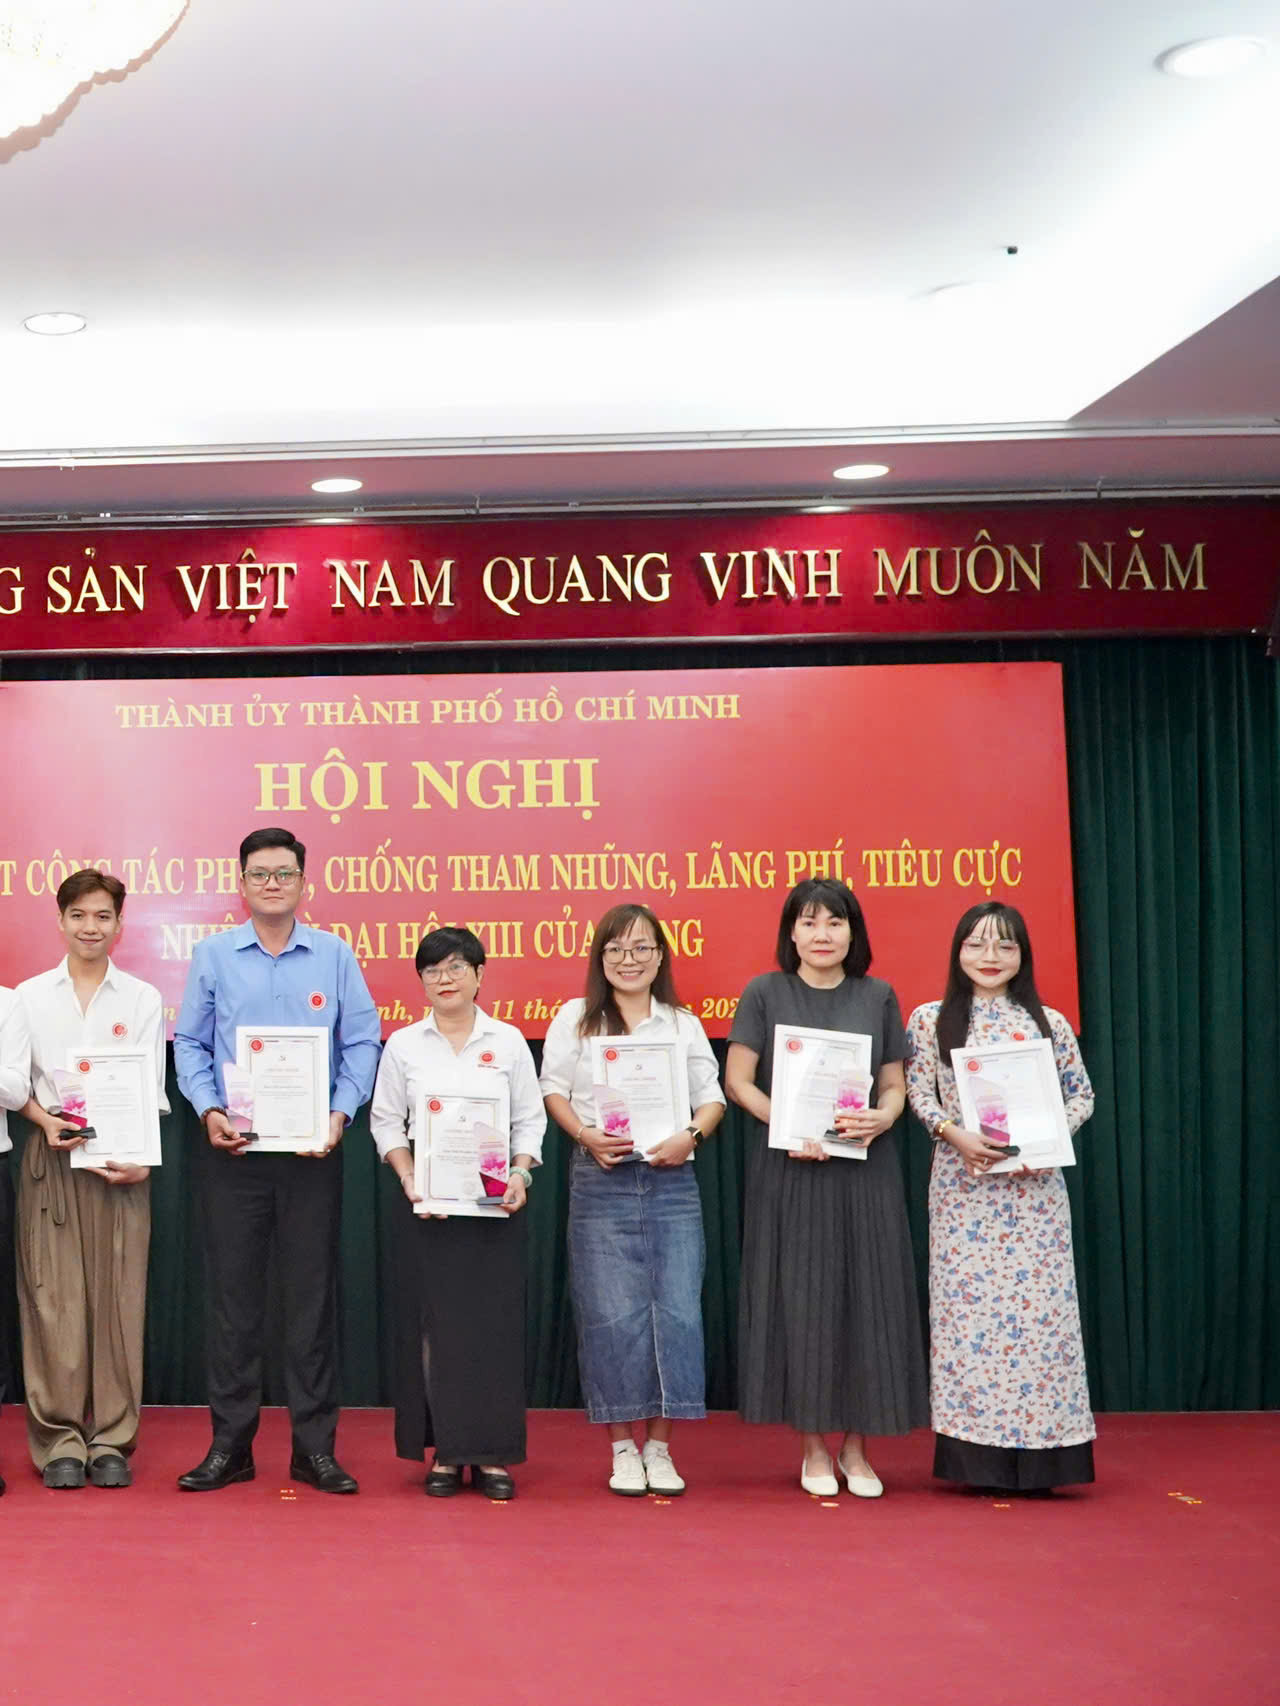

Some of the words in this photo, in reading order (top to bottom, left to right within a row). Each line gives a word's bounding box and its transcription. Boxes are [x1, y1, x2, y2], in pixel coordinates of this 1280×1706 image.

[47, 547, 148, 613] SẢN
[175, 548, 297, 624] VIỆT
[327, 559, 455, 608] NAM
[482, 553, 672, 615] QUANG
[700, 547, 843, 600] VINH
[873, 529, 1044, 596] MUÔN
[1076, 527, 1208, 591] NĂM
[116, 696, 234, 729] THÀNH
[244, 693, 291, 727] ỦY
[300, 694, 421, 726] THÀNH
[430, 688, 503, 724] PHỐ
[513, 685, 564, 723] HỒ
[575, 689, 637, 721] CHÍ
[646, 694, 741, 720] MINH
[254, 747, 389, 825] HỘI
[411, 758, 600, 821] NGHỊ
[122, 847, 185, 896] TÁC
[324, 838, 439, 894] CHỐNG
[447, 854, 541, 892] THAM
[549, 842, 677, 898] NHŨNG,
[685, 841, 777, 890] LÃNG
[784, 838, 854, 891] PHÍ,
[862, 838, 943, 888] TIÊU
[953, 840, 1022, 897] CỰC
[533, 904, 596, 959] CỦA
[652, 911, 705, 958] NG
[491, 999, 515, 1020] 11
[700, 997, 740, 1019] 202
